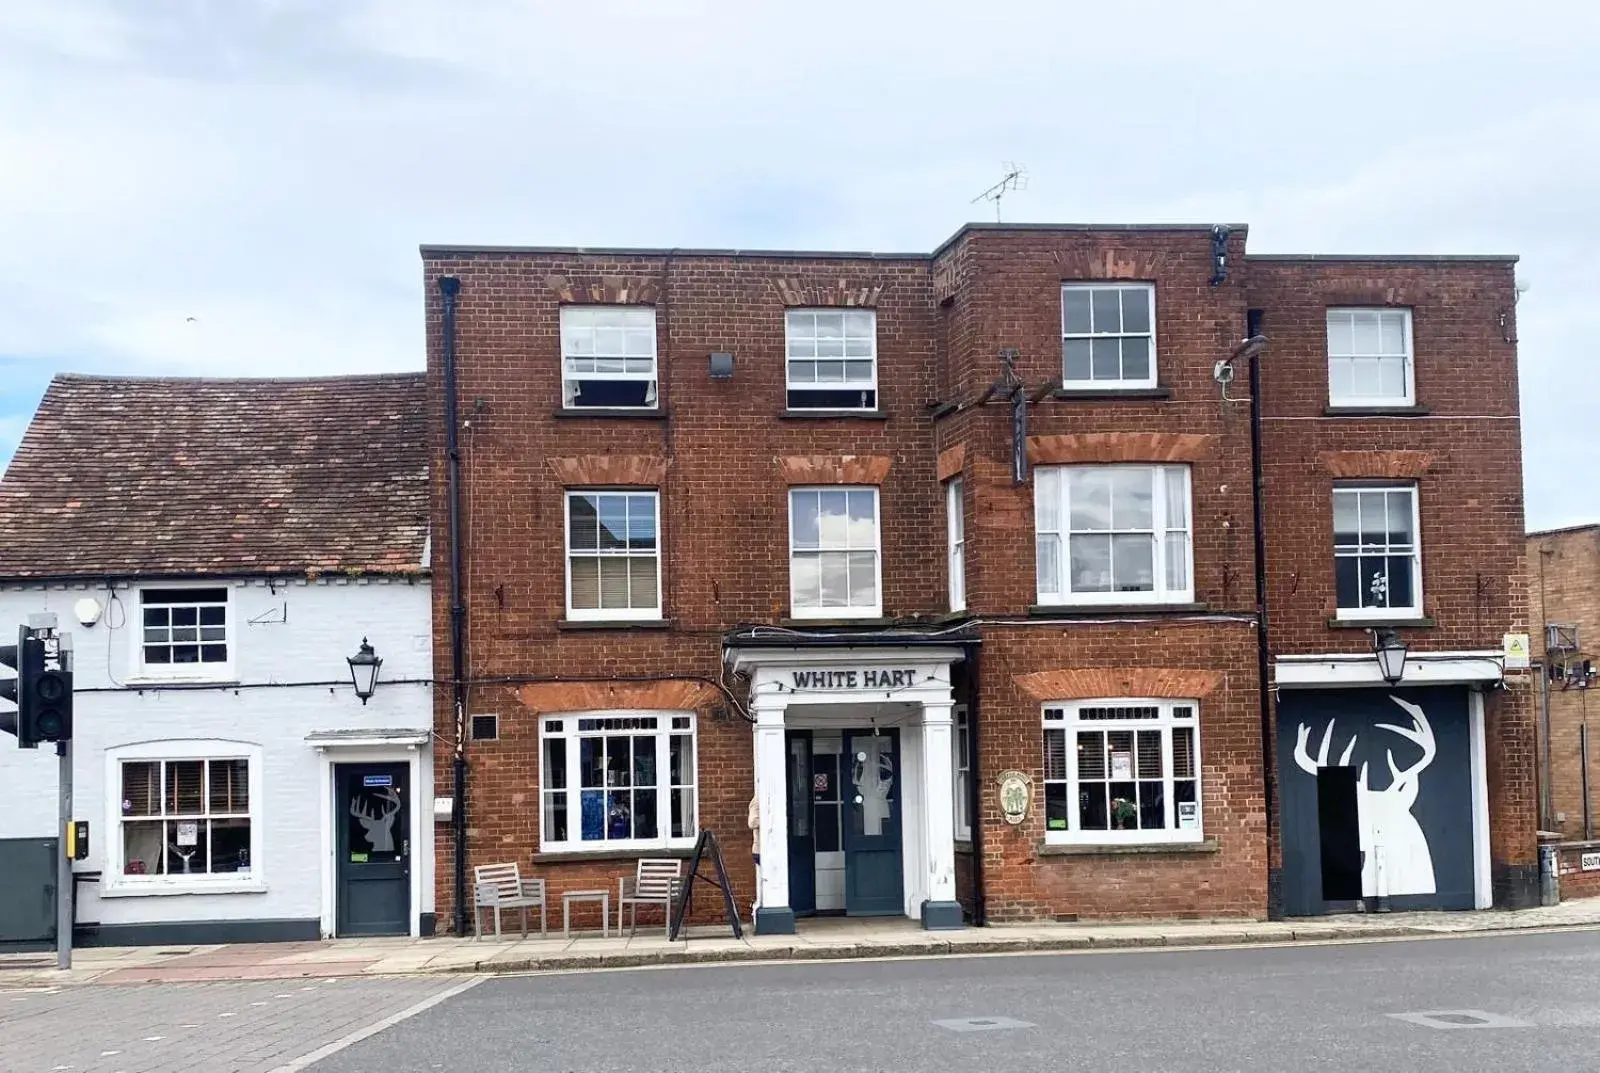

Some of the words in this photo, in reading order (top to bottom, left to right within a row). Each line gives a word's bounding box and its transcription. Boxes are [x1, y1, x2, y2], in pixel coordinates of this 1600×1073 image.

[793, 671, 857, 688] WHITE
[863, 669, 916, 687] HART
[1583, 856, 1600, 867] SOUT
